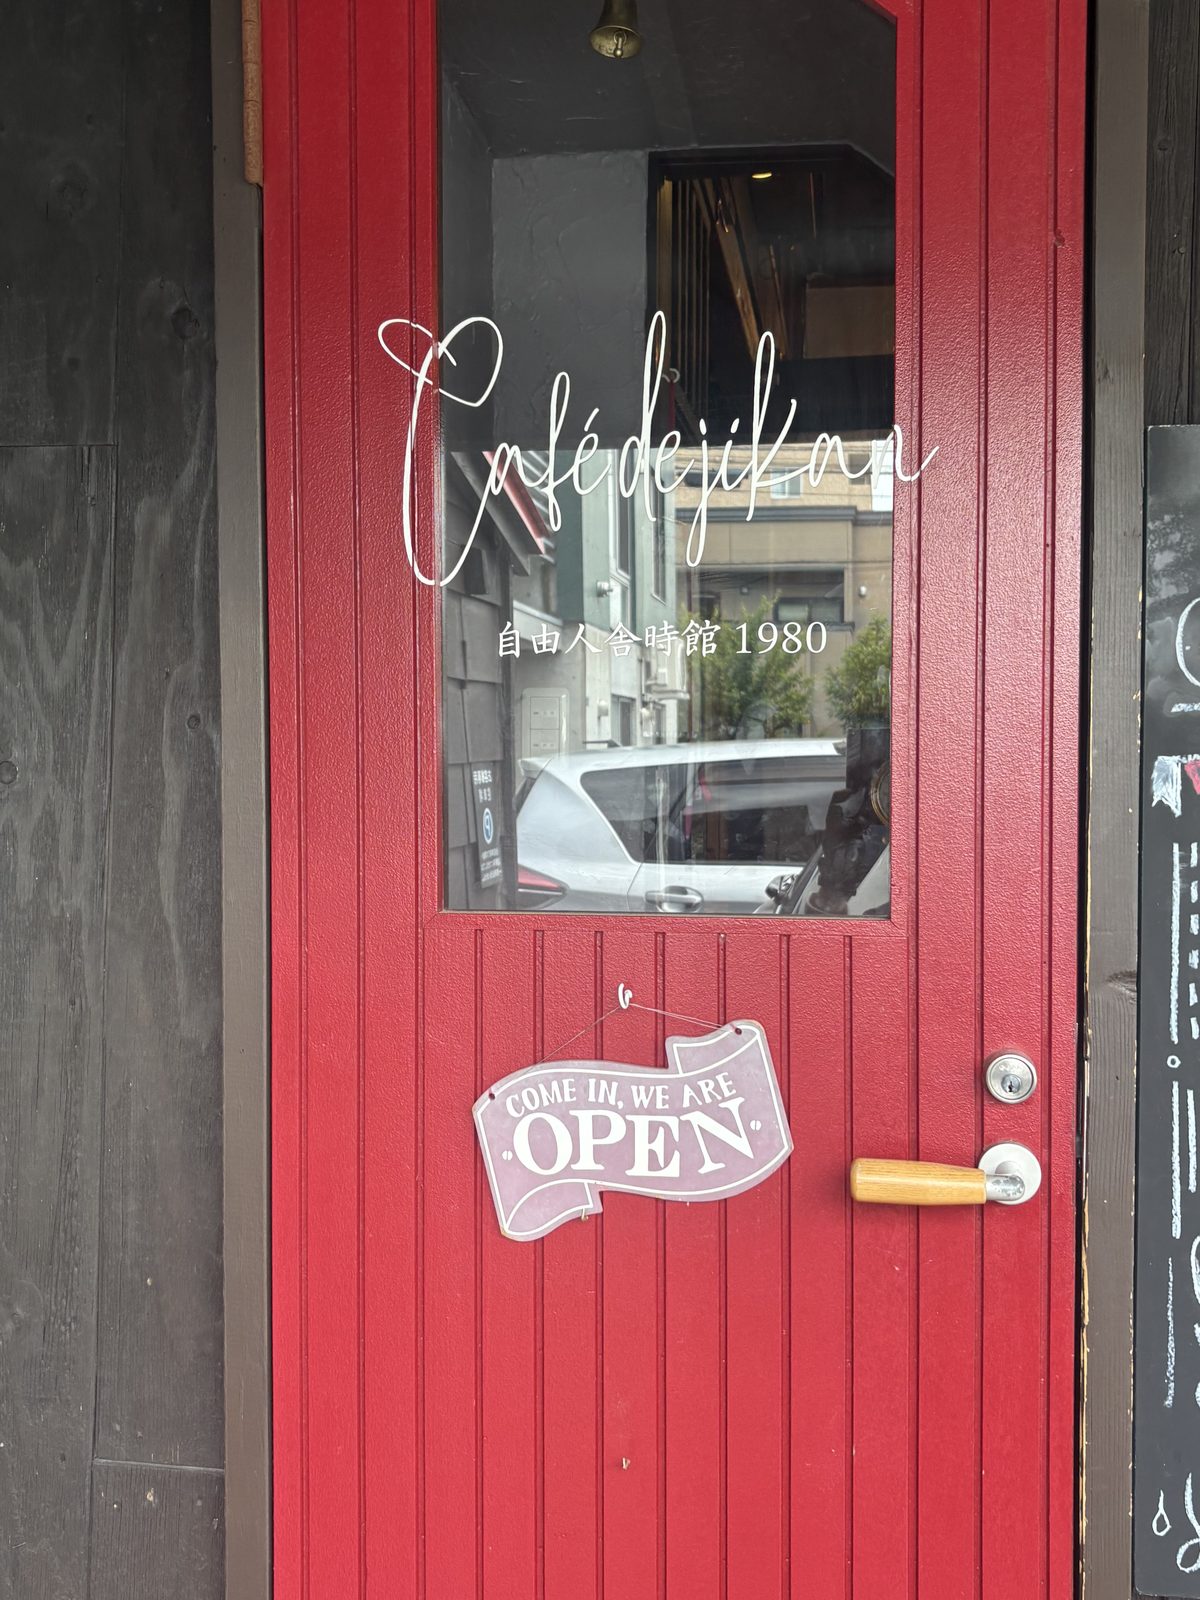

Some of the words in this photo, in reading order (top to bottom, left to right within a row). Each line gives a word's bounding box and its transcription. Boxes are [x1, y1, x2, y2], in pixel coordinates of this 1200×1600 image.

[498, 619, 721, 658] 自由人舎時館
[736, 620, 828, 655] 1980
[505, 1078, 576, 1118] COME
[588, 1078, 625, 1110] IN,
[630, 1084, 669, 1110] WE
[682, 1072, 737, 1108] ARE
[512, 1097, 755, 1178] OPEN
